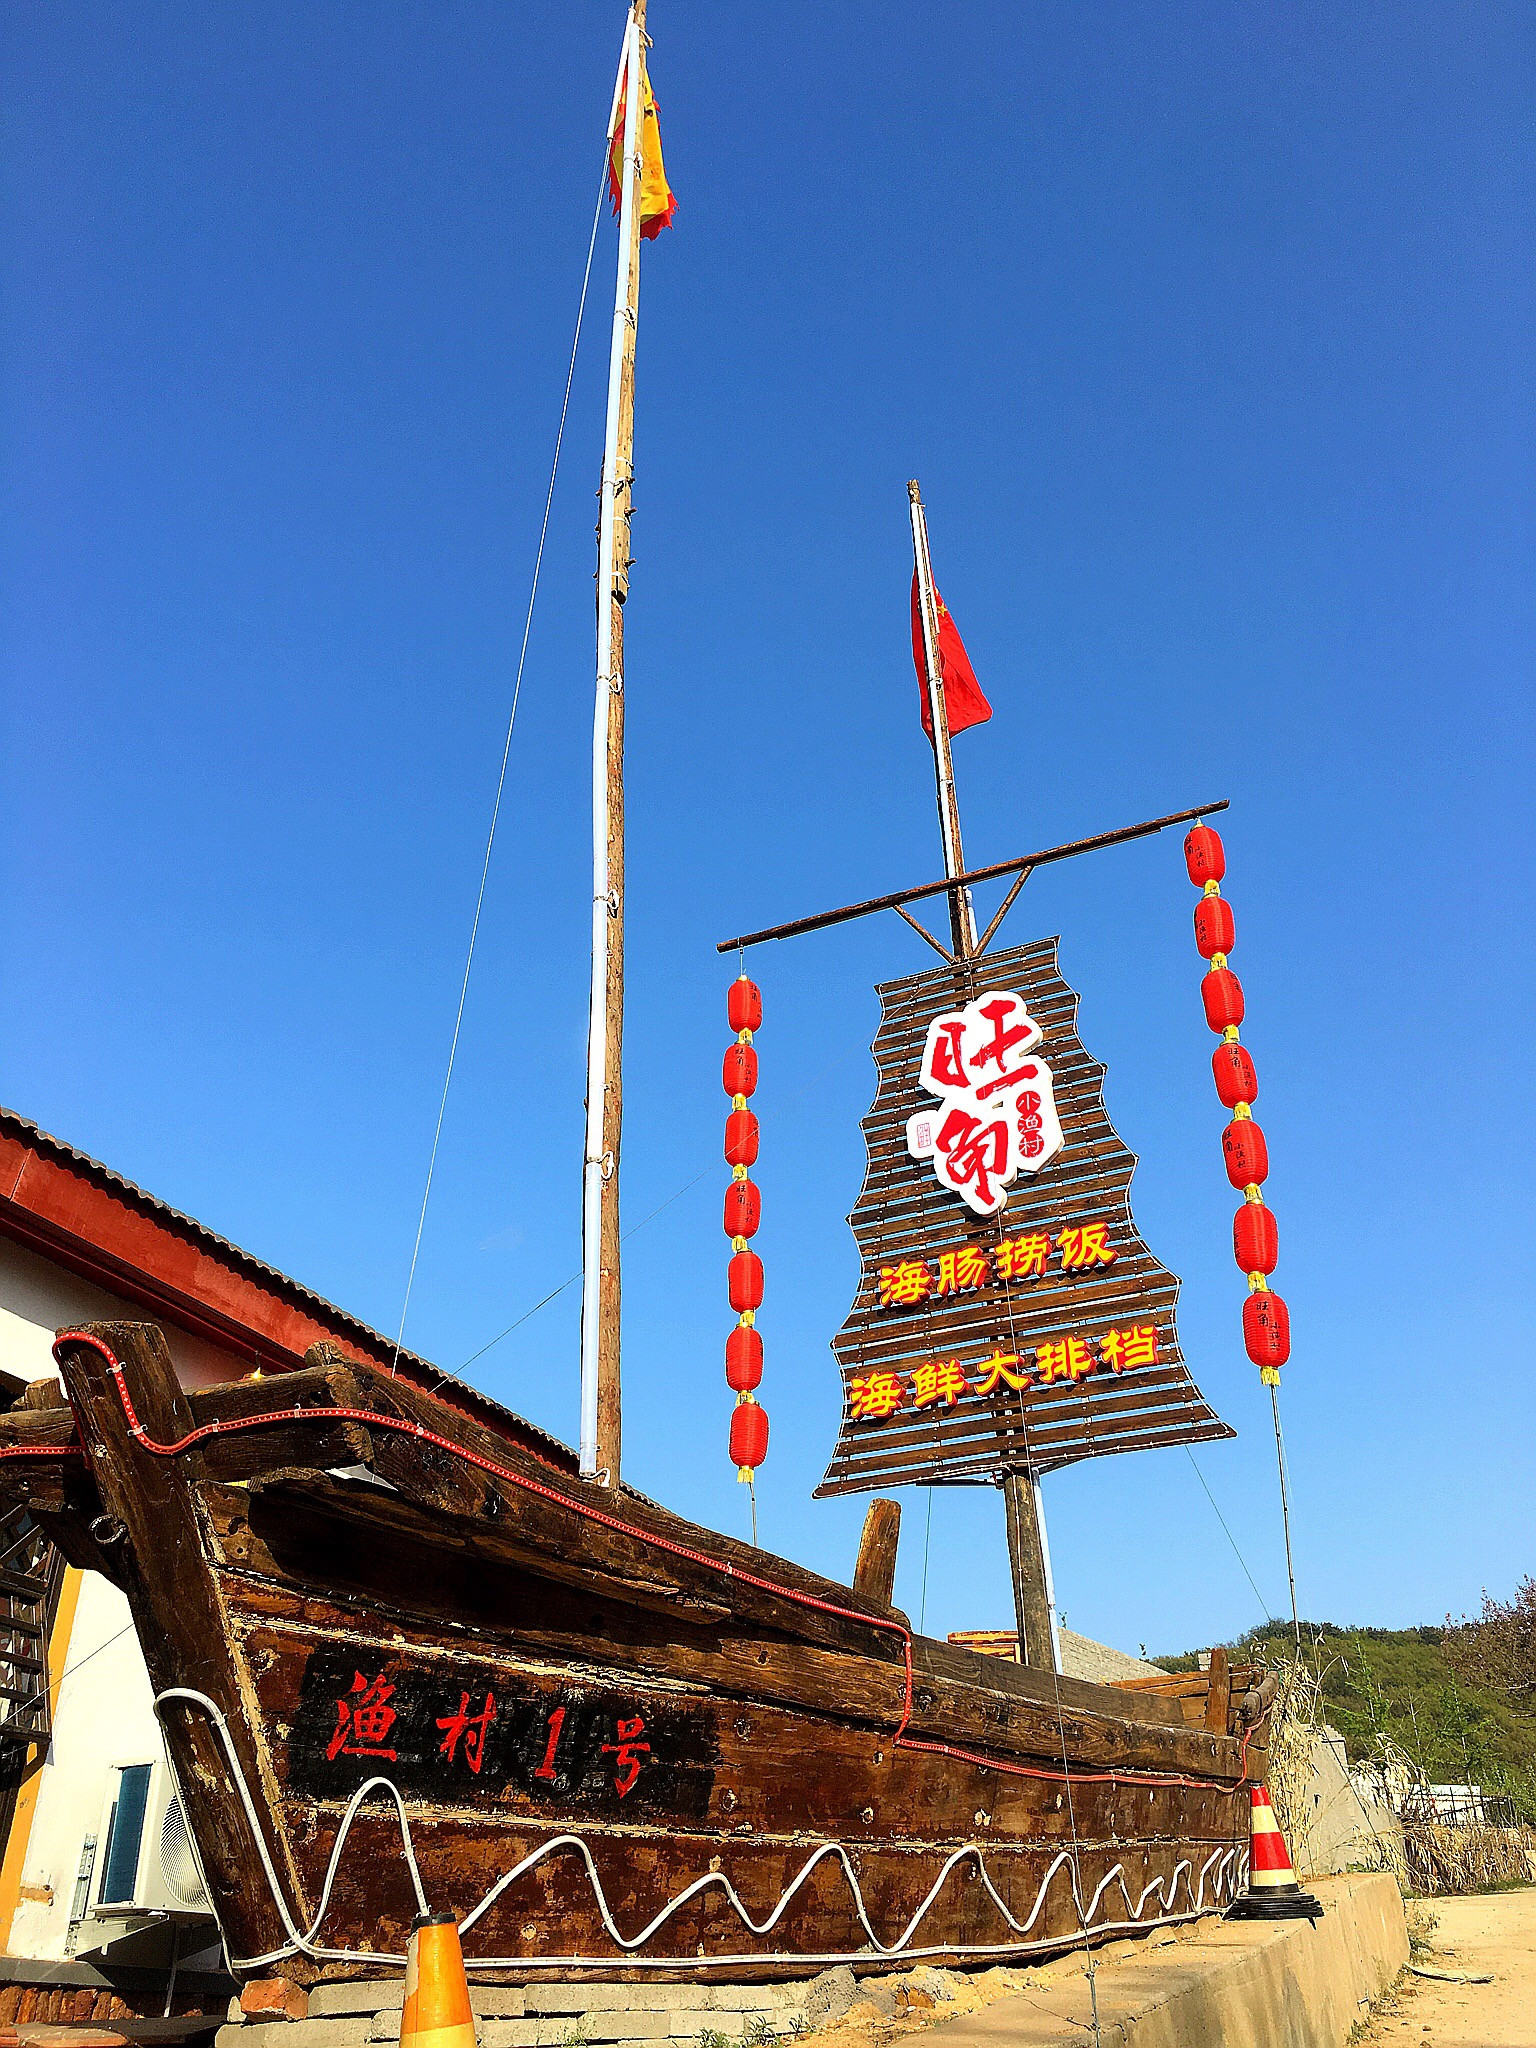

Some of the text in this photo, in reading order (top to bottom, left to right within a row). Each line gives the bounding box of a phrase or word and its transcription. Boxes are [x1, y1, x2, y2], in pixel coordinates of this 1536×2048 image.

[1228, 1047, 1241, 1068] 旺角
[1016, 1090, 1044, 1158] 小渔村
[736, 1184, 747, 1205] 旺角
[878, 1221, 1119, 1307] 海肠捞饭
[1256, 1301, 1270, 1327] 旺角
[850, 1324, 1160, 1421] 海鲜大排档
